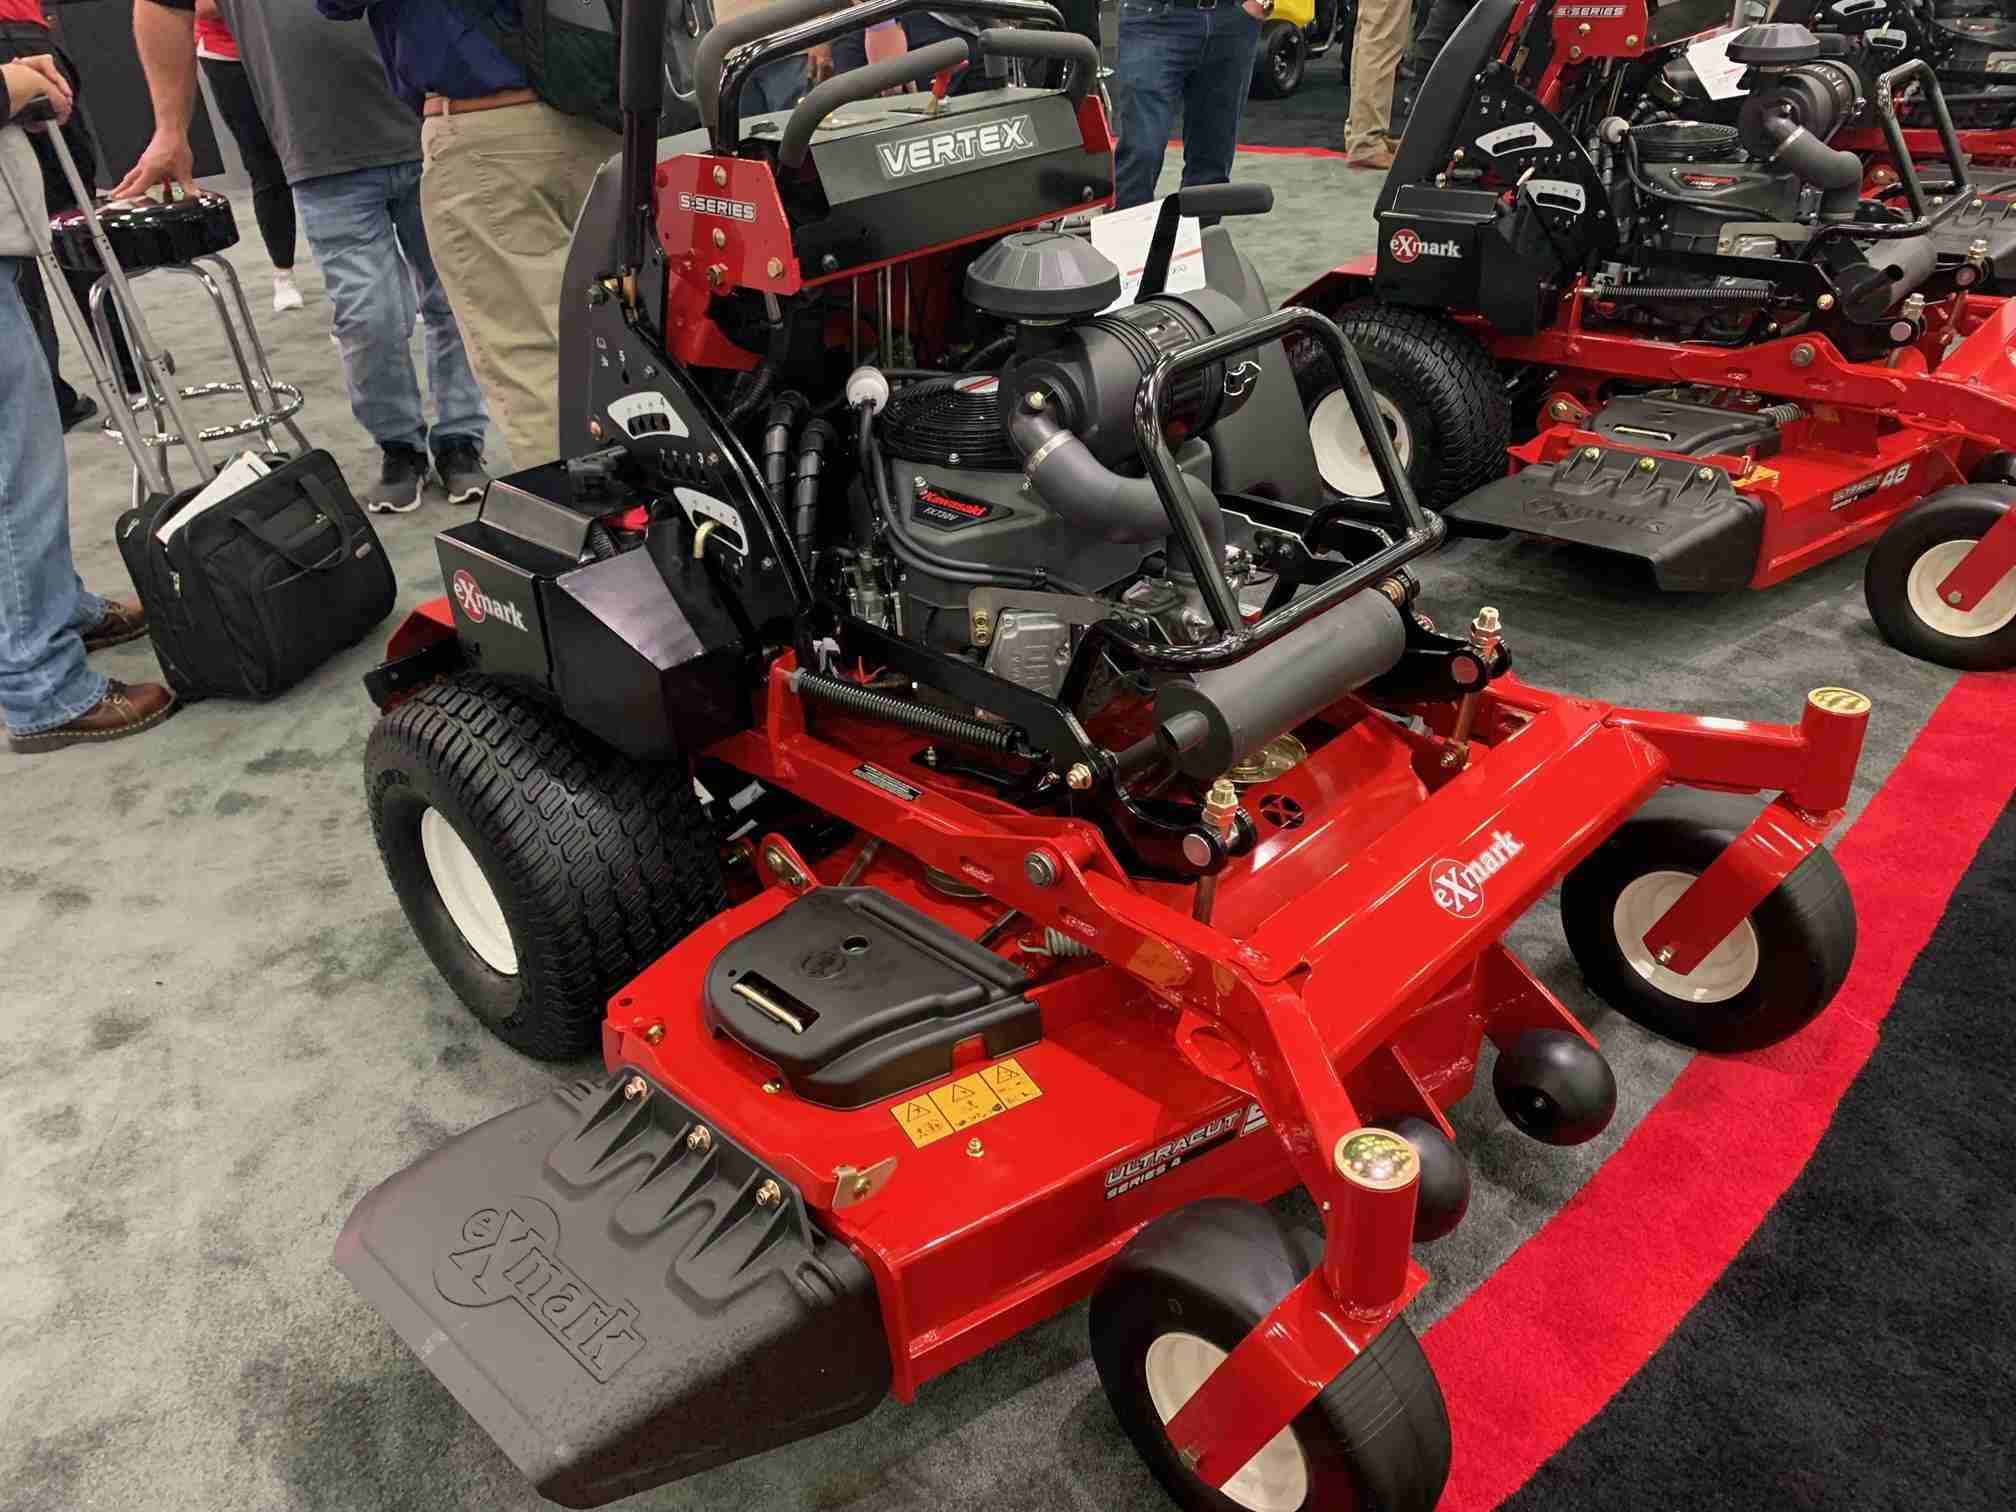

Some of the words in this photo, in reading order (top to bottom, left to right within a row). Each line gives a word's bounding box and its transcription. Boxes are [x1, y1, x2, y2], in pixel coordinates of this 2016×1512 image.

[881, 118, 1029, 174] VERTEX
[1390, 234, 1462, 258] eXmark
[1881, 463, 1911, 488] 48
[454, 578, 528, 632] eXmark
[1435, 830, 1524, 912] eXmark
[1105, 1109, 1243, 1187] ULTRACUT
[1106, 1166, 1167, 1200] SERIES
[448, 1208, 636, 1370] eXmark
